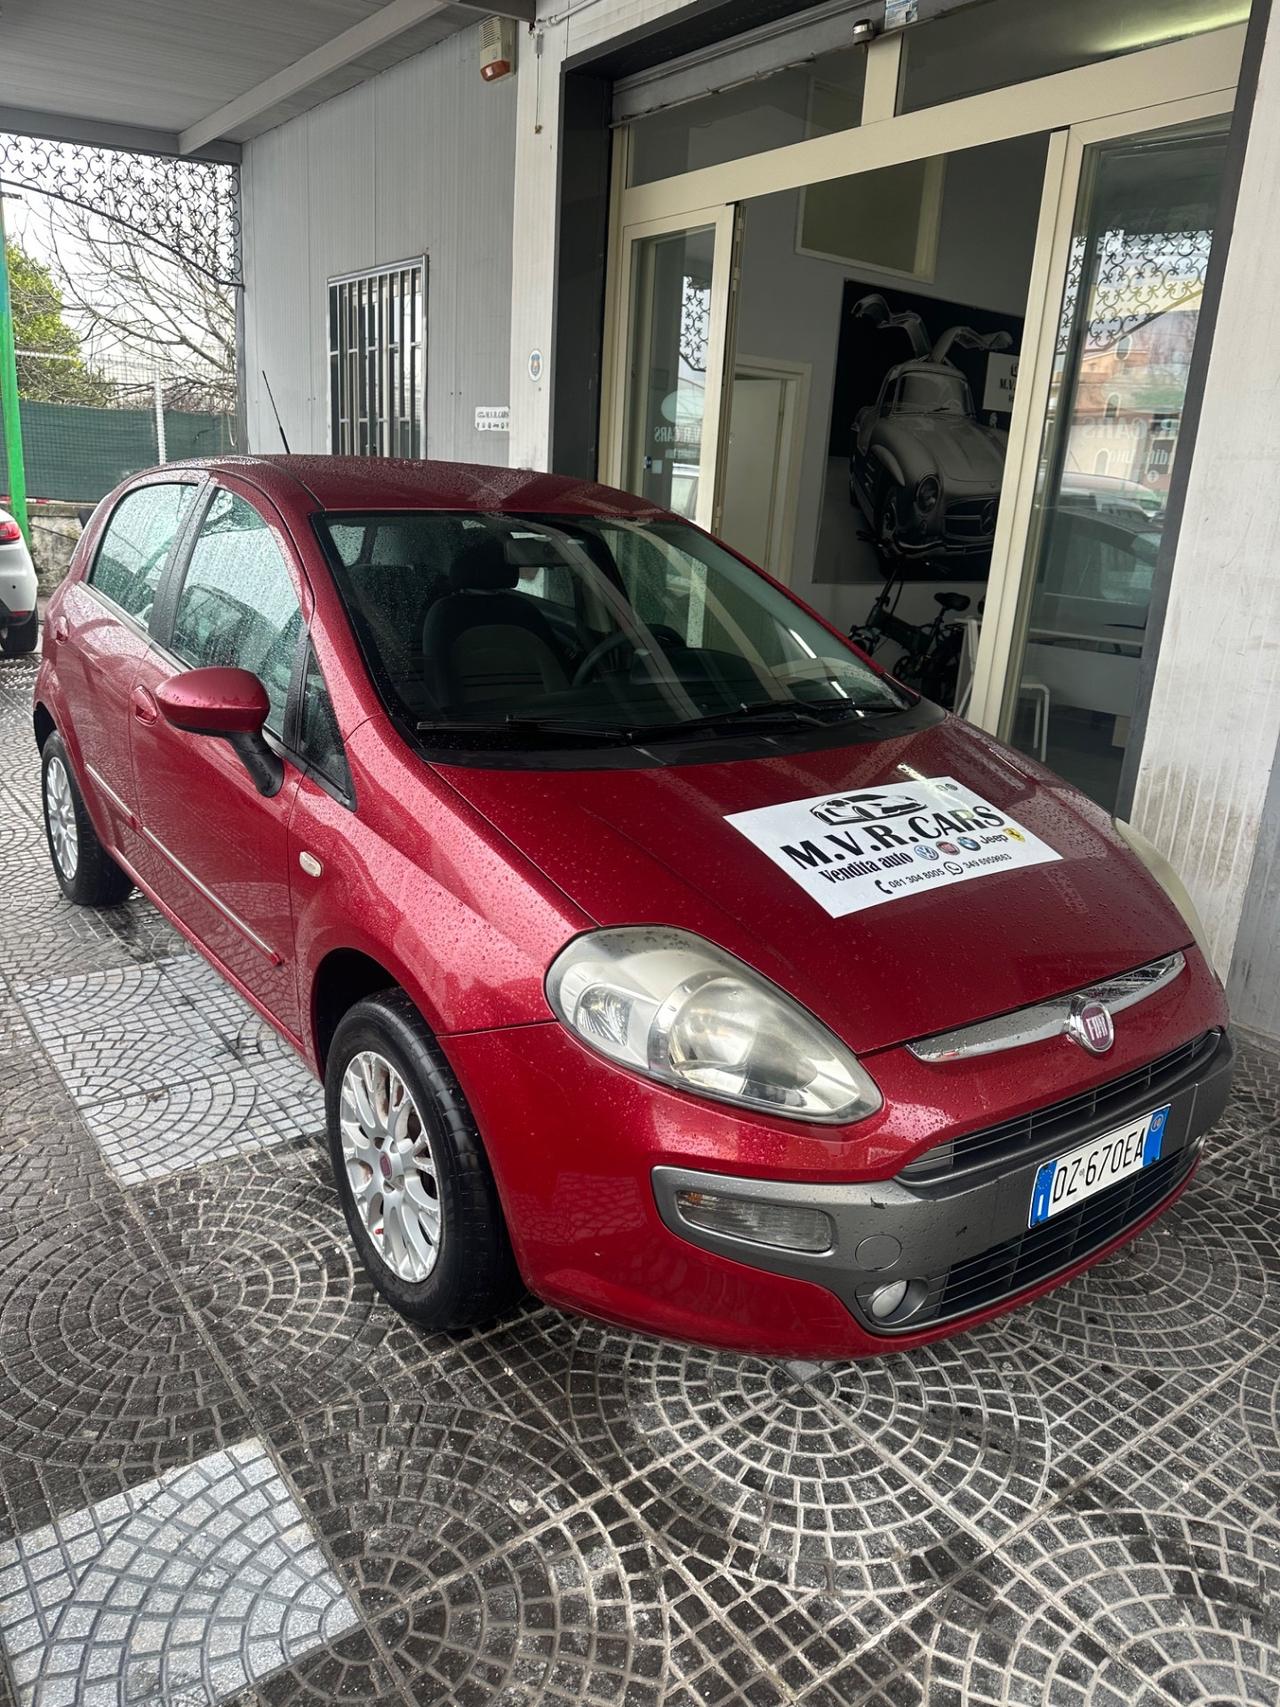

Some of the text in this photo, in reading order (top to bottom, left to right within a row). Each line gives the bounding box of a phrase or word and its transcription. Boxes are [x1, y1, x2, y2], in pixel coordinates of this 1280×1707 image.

[780, 805, 1005, 870] M.V.R.CARS
[980, 834, 1008, 845] Jeep
[818, 852, 914, 883] Vendita auto
[888, 868, 945, 888] 081 304 8005
[1086, 1013, 1108, 1040] FIAT
